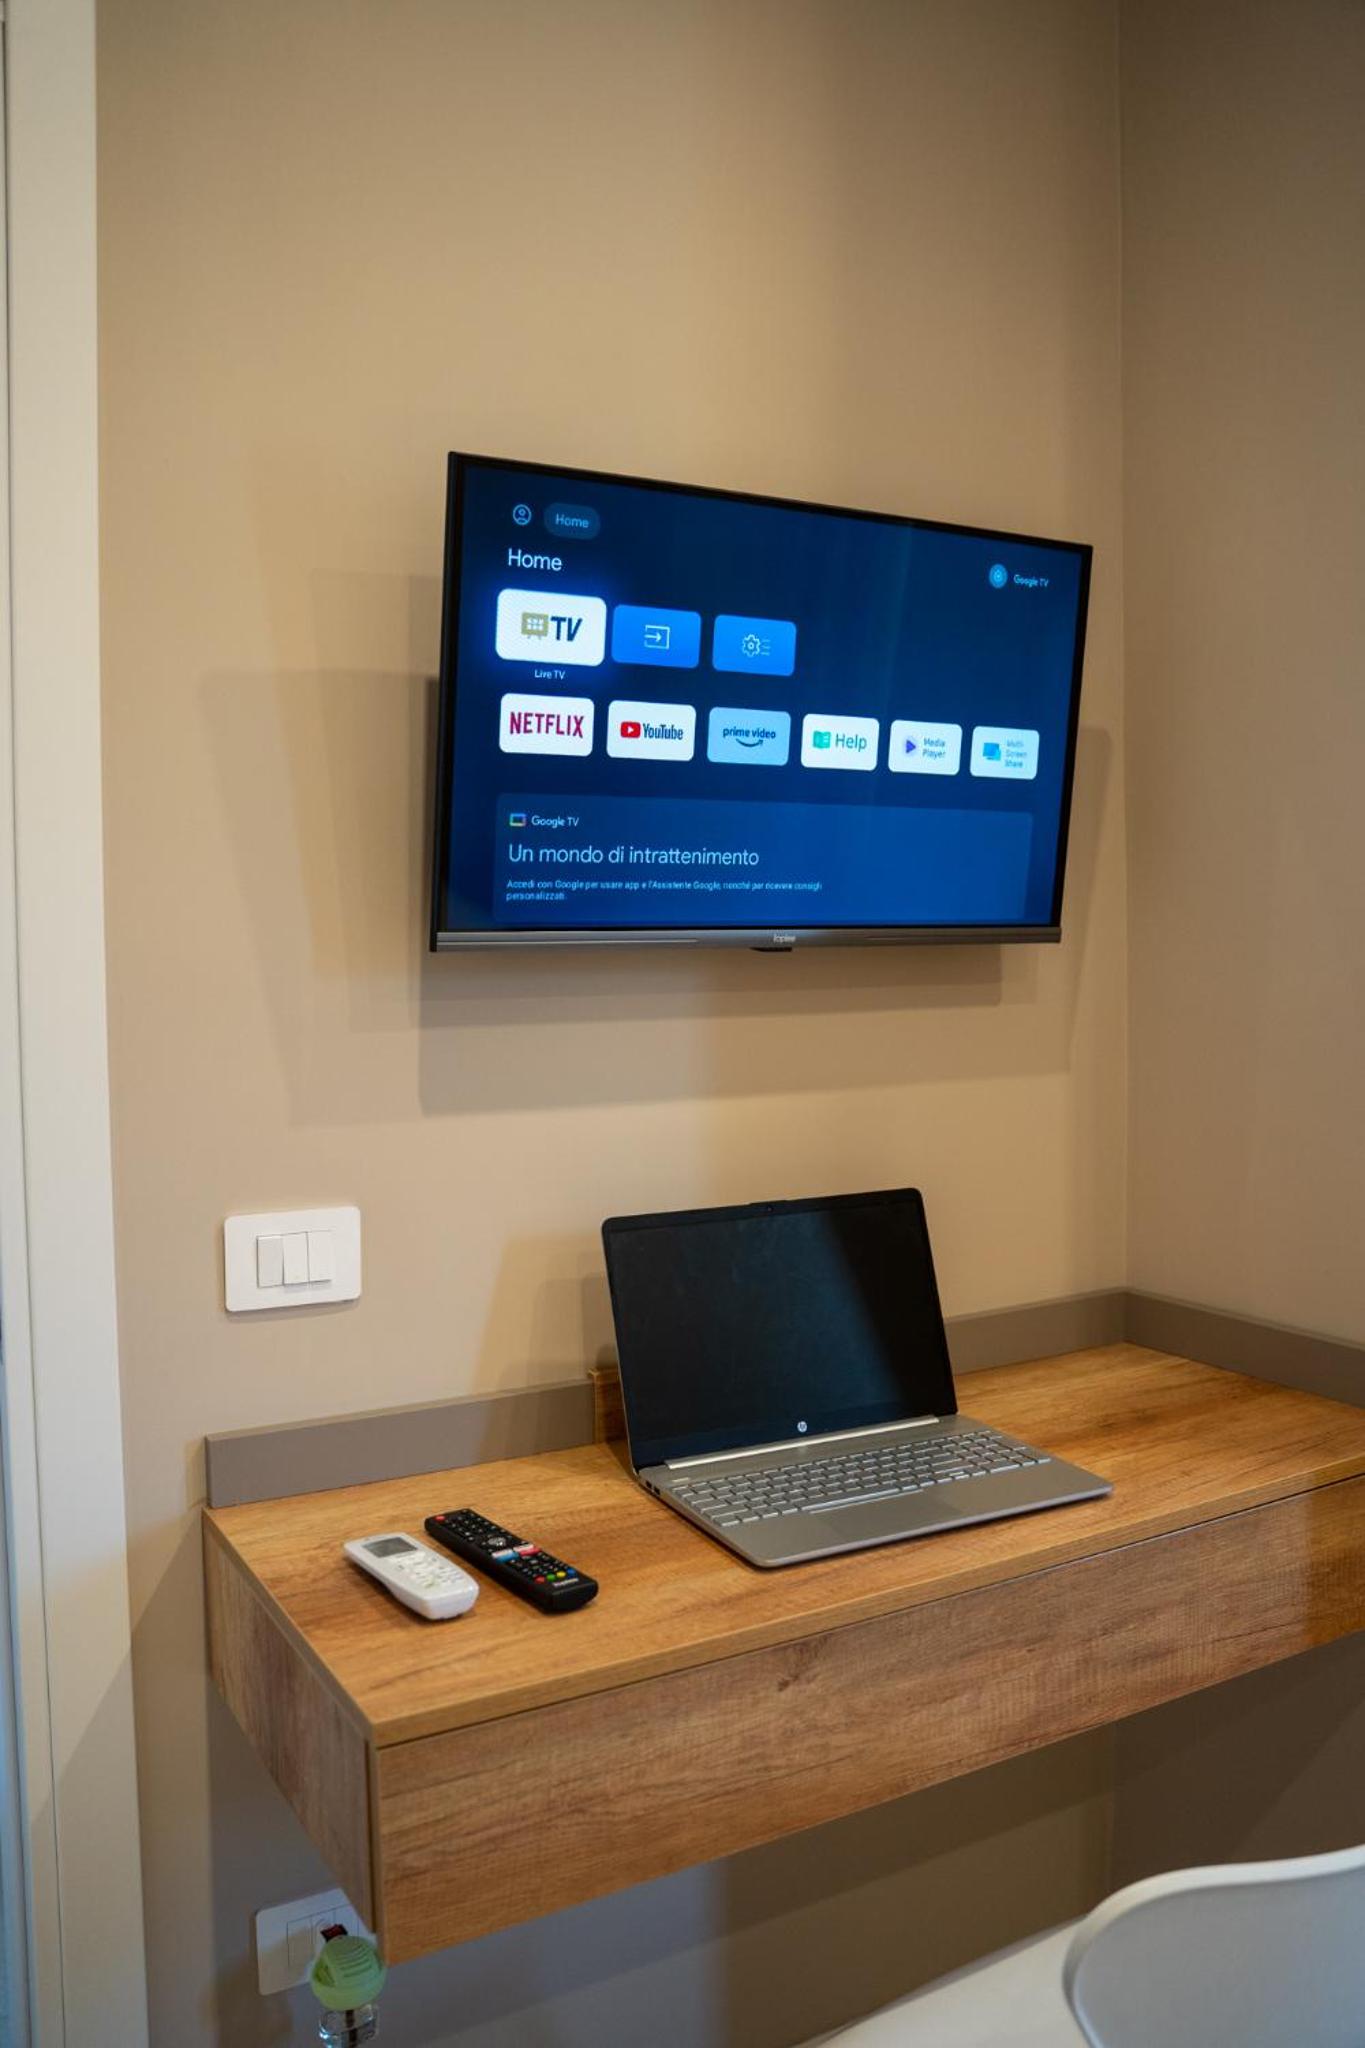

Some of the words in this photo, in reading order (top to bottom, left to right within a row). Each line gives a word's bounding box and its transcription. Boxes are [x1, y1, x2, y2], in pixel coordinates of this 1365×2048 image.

[556, 513, 589, 528] Home
[508, 548, 562, 571] Home
[550, 616, 583, 642] TV
[534, 669, 552, 679] Live
[553, 670, 565, 680] TV
[509, 711, 584, 738] NETFLIX
[642, 723, 683, 741] YouTube
[722, 726, 750, 739] prime
[751, 728, 776, 739] video
[835, 733, 868, 751] Help
[922, 737, 946, 748] Media
[922, 749, 947, 759] Player
[531, 815, 565, 829] Google
[567, 816, 579, 828] TV
[508, 844, 534, 863] Un
[538, 845, 604, 864] mondo
[608, 846, 625, 864] di
[628, 846, 760, 866] intrattenimento
[555, 880, 585, 891] Google
